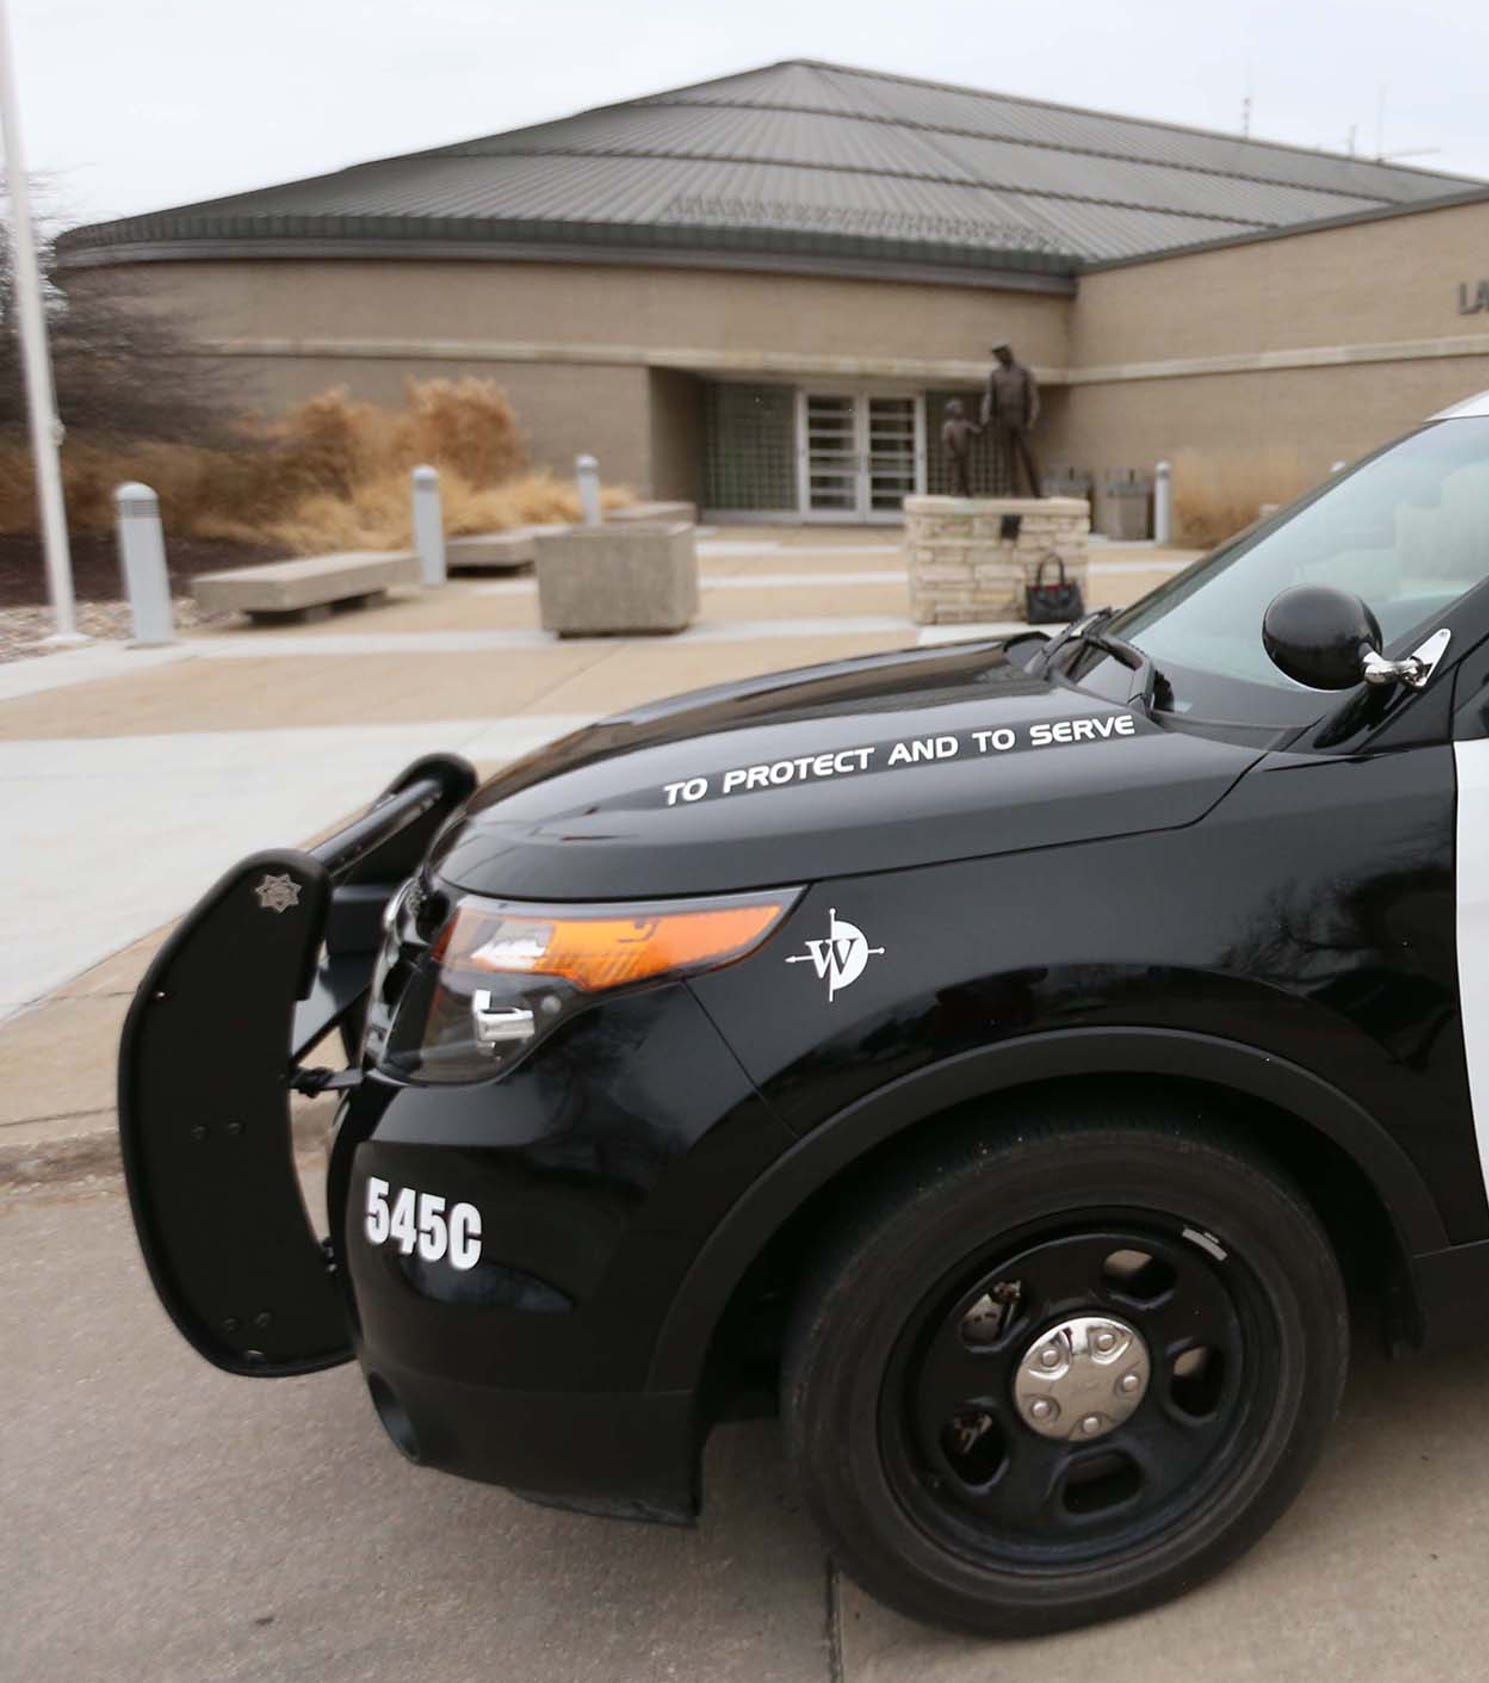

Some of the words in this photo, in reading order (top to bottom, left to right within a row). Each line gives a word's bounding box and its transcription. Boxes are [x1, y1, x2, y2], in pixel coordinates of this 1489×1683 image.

[664, 778, 708, 805] TO
[722, 747, 875, 793] PROTECT
[888, 735, 959, 766] AND
[972, 728, 1016, 753] TO
[1029, 715, 1135, 747] SERVE
[366, 1176, 482, 1270] 545C
